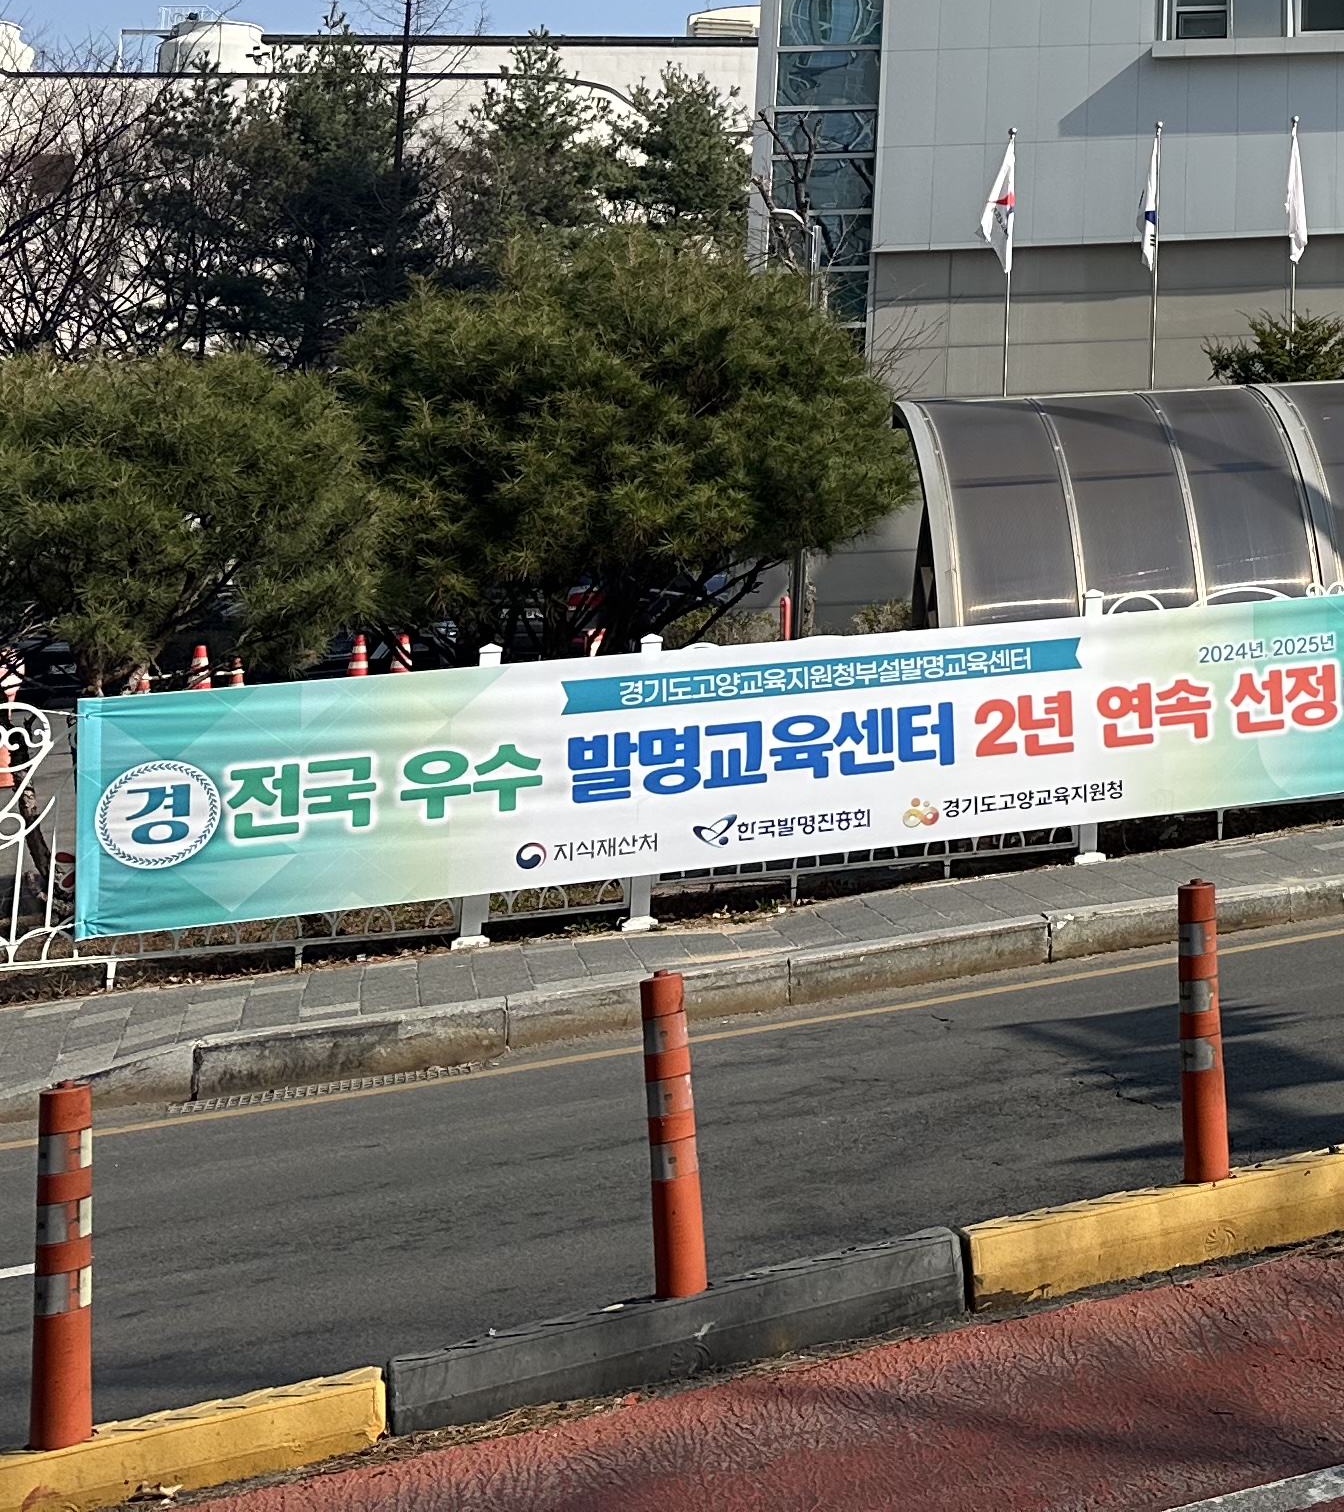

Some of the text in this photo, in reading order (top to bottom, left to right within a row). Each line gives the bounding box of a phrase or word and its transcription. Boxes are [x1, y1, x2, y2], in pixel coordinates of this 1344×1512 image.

[619, 646, 1032, 706] 경기도고양교육지원청부설발명교육센터
[1272, 634, 1335, 657] 2025년
[226, 664, 1338, 838] 전국 우수 발명교육센터 2년 연속 선정
[125, 783, 190, 845] 경
[553, 779, 1124, 862] 지식재산처 한국발명진흥회 경기도고양교육지원청
